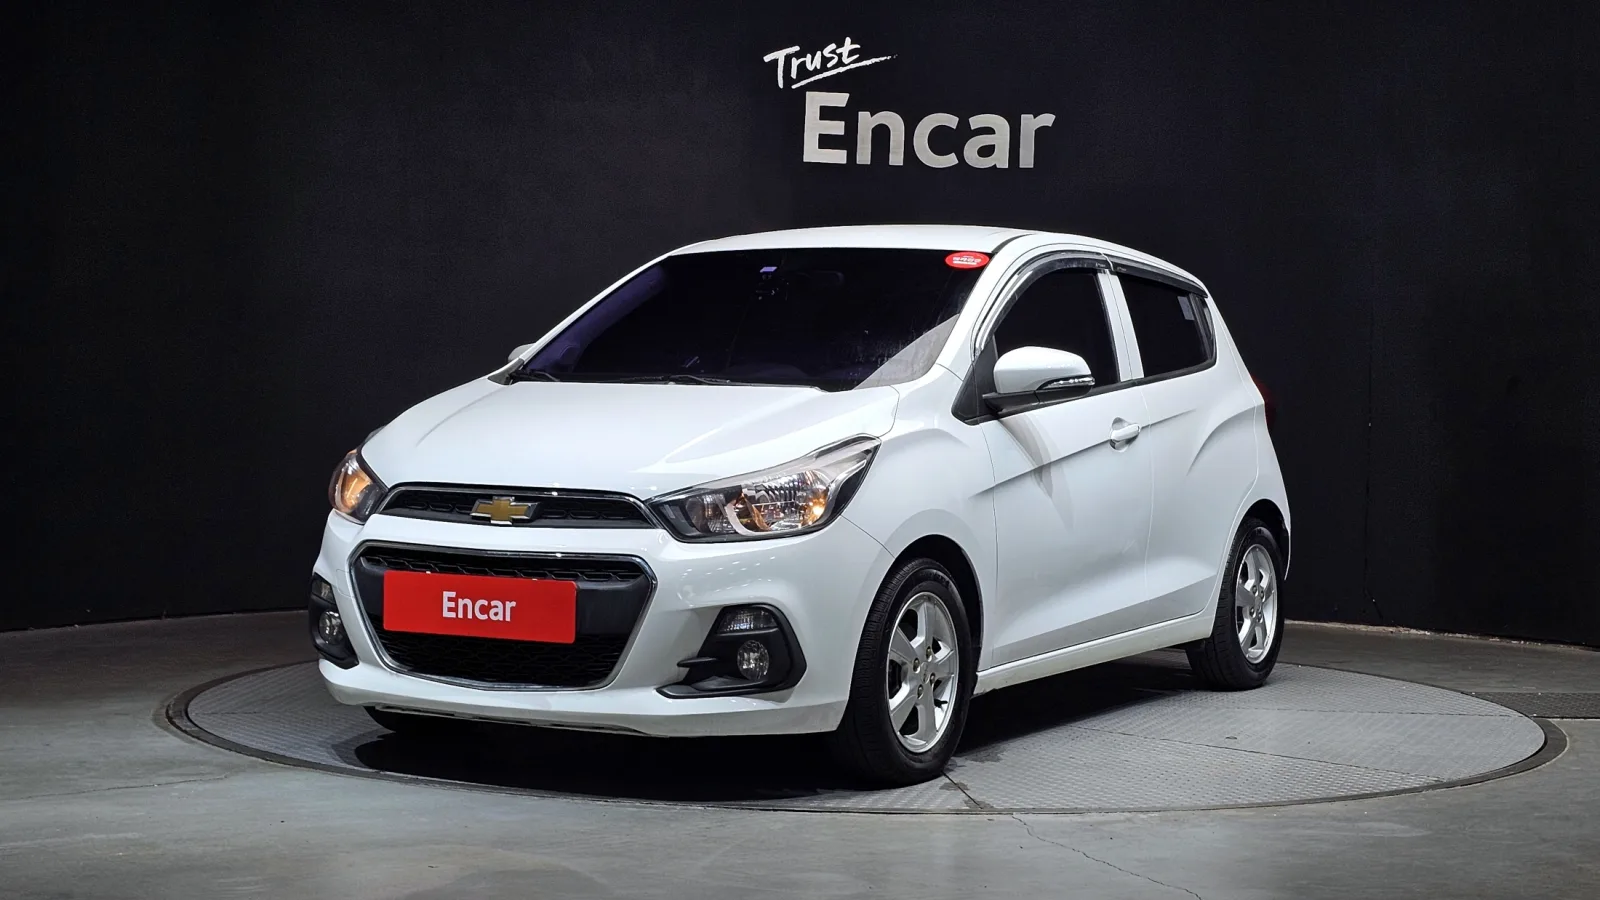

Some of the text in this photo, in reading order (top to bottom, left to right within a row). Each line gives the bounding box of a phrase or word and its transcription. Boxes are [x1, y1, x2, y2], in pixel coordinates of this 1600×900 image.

[763, 37, 861, 89] Trust
[803, 91, 1056, 168] Encar
[442, 591, 517, 622] Encar
